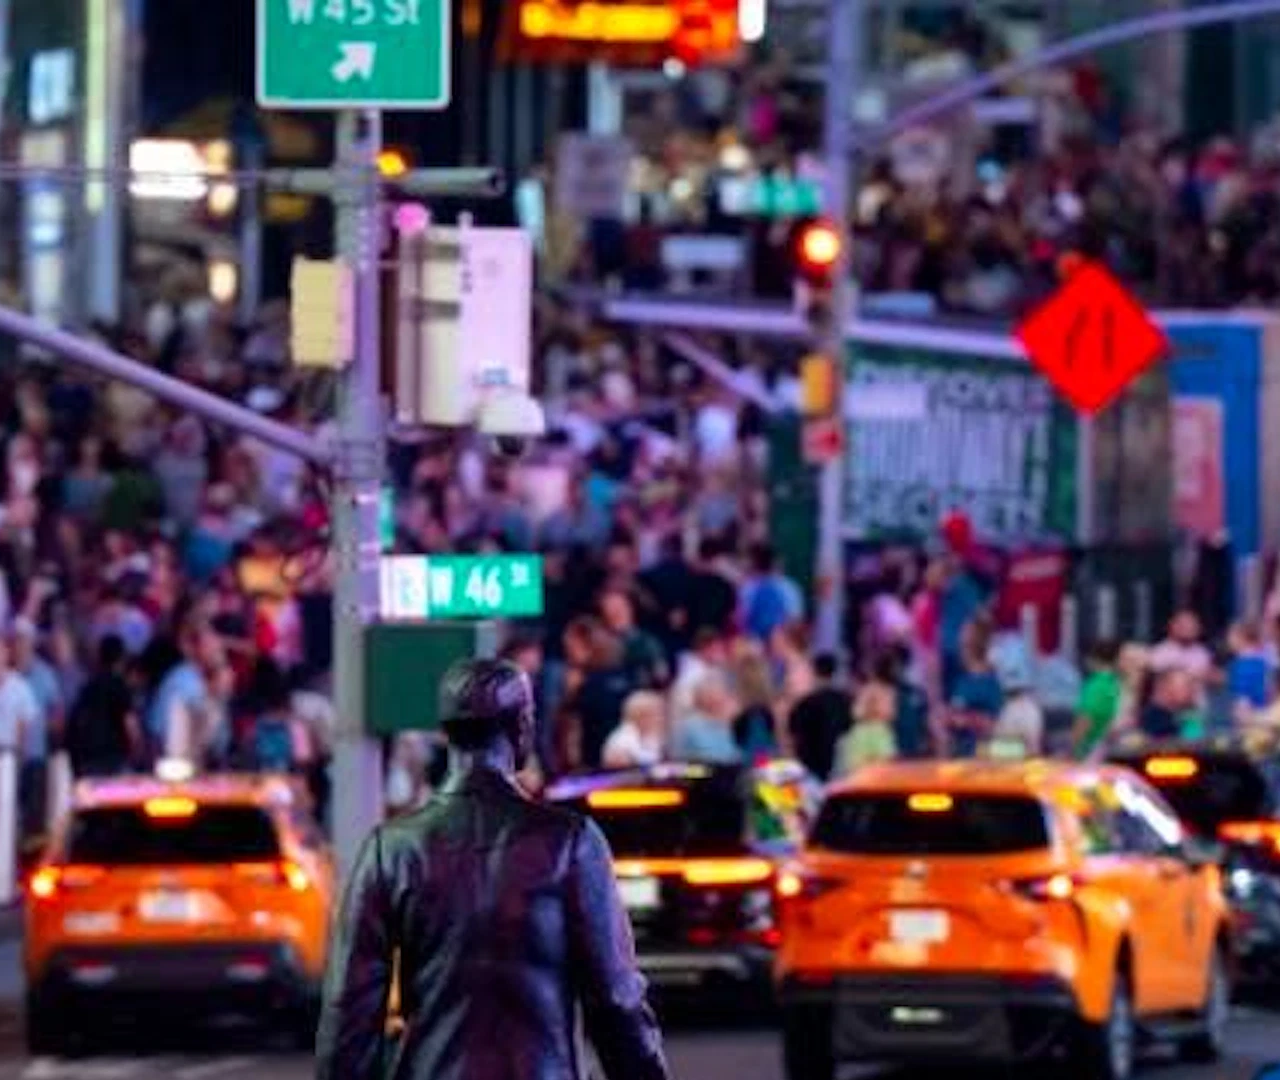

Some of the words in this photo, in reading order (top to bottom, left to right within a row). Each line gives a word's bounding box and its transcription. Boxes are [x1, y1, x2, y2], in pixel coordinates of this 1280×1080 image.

[288, 0, 314, 25] W
[323, 0, 374, 25] 45
[382, 0, 419, 25] St
[431, 566, 453, 606] W
[465, 564, 503, 608] 46
